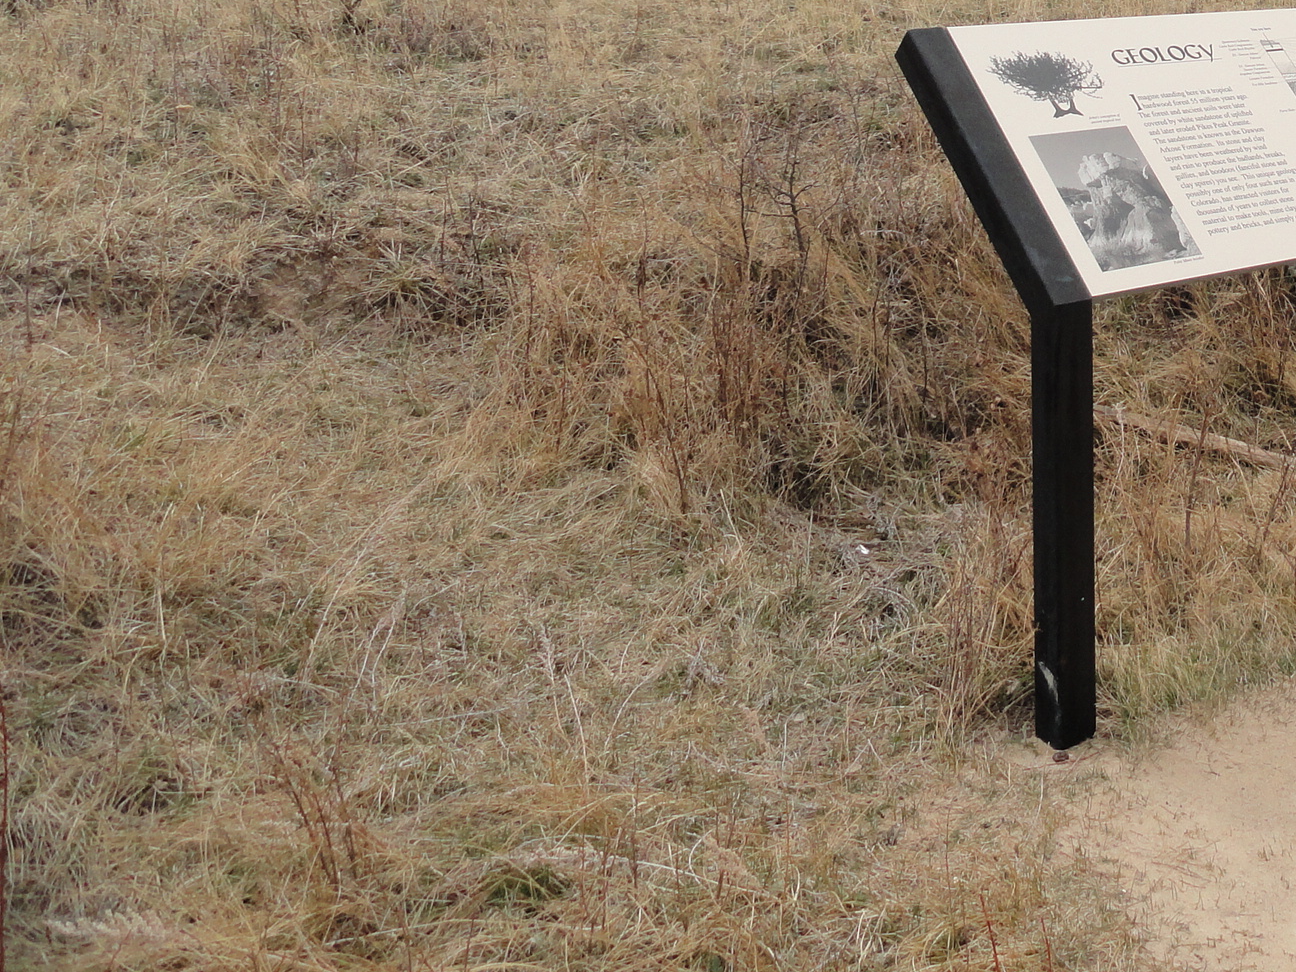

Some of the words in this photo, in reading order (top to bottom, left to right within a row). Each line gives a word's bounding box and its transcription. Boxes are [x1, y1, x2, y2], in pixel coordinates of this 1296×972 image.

[1111, 44, 1213, 65] GEOLOGY
[1231, 110, 1253, 118] uplifted
[1214, 147, 1244, 155] weathered
[1202, 159, 1226, 167] produce
[1175, 172, 1198, 181] gullies,
[1235, 163, 1261, 172] (fanciful
[1194, 178, 1216, 187] spires)
[1186, 189, 1212, 199] possibly
[1190, 198, 1222, 206] Colorado,
[1233, 192, 1259, 200] attracted
[1195, 206, 1227, 215] thousands
[1259, 198, 1279, 206] collect
[1202, 216, 1227, 225] material
[1208, 227, 1230, 236] pottery
